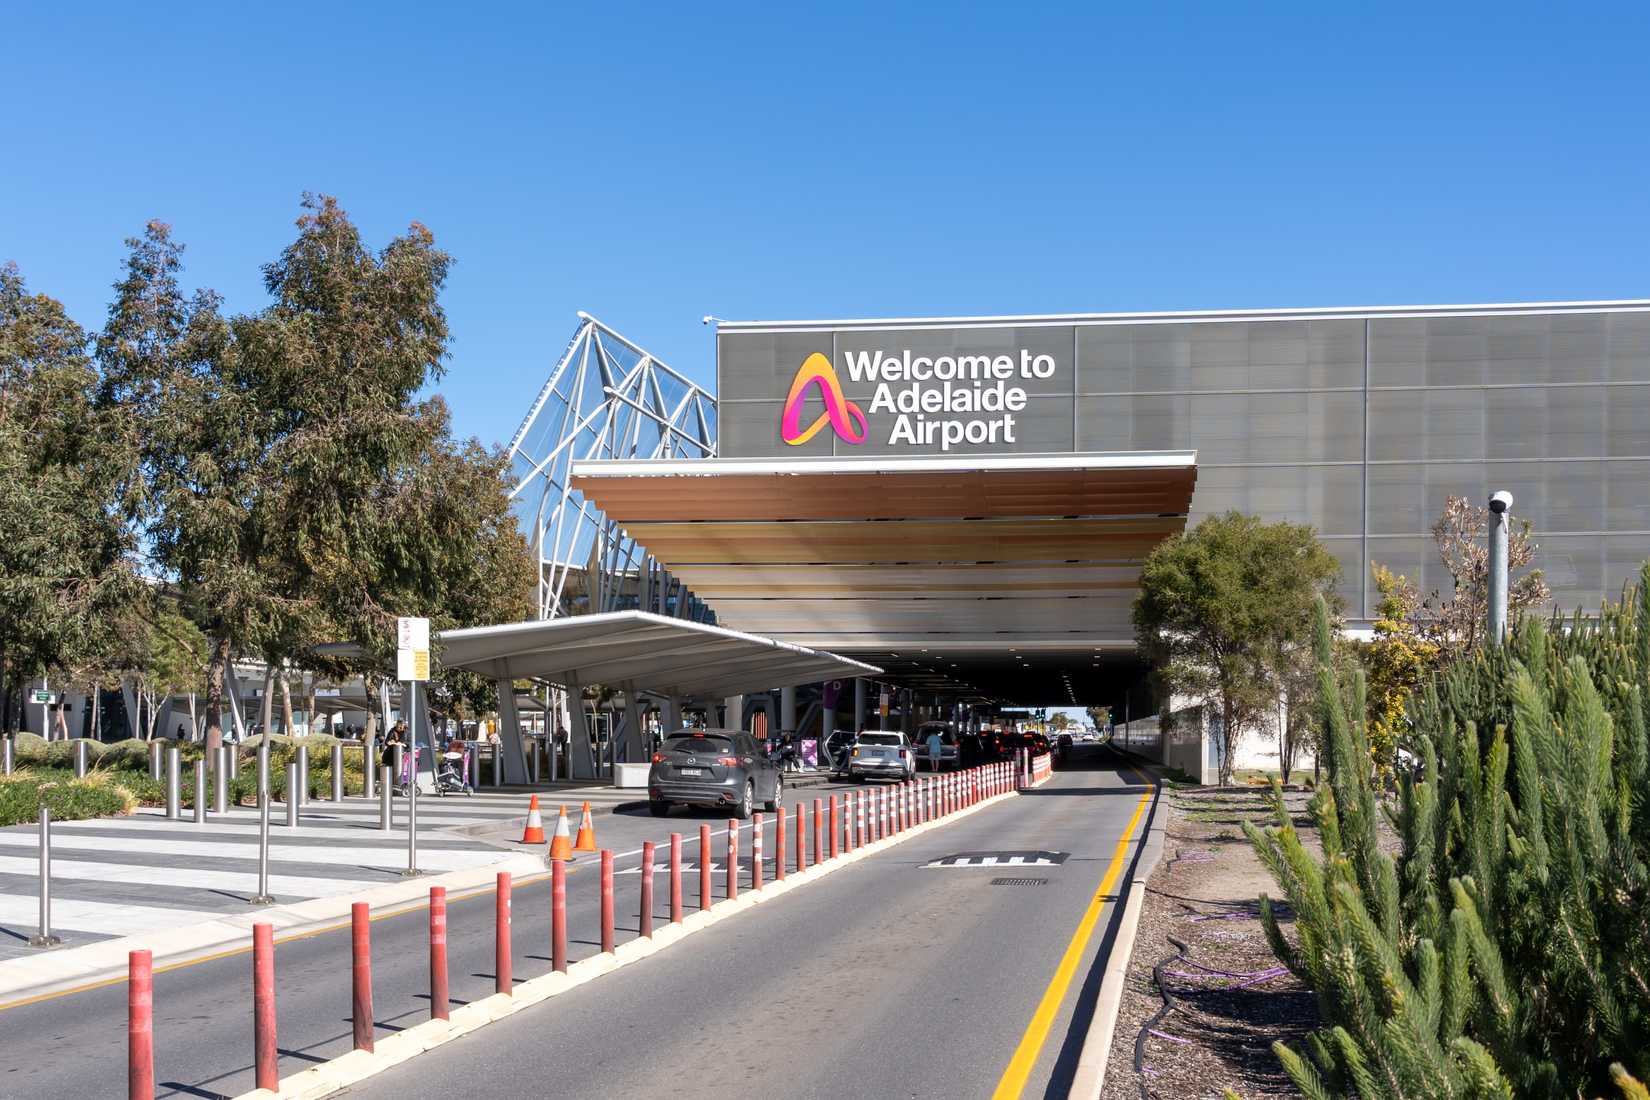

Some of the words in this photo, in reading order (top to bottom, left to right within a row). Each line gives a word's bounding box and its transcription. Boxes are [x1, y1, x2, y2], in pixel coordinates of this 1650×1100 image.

[845, 350, 1013, 382] Welcome
[1020, 349, 1056, 379] to
[868, 381, 1027, 414] Adelaide
[888, 414, 1016, 450] Airport
